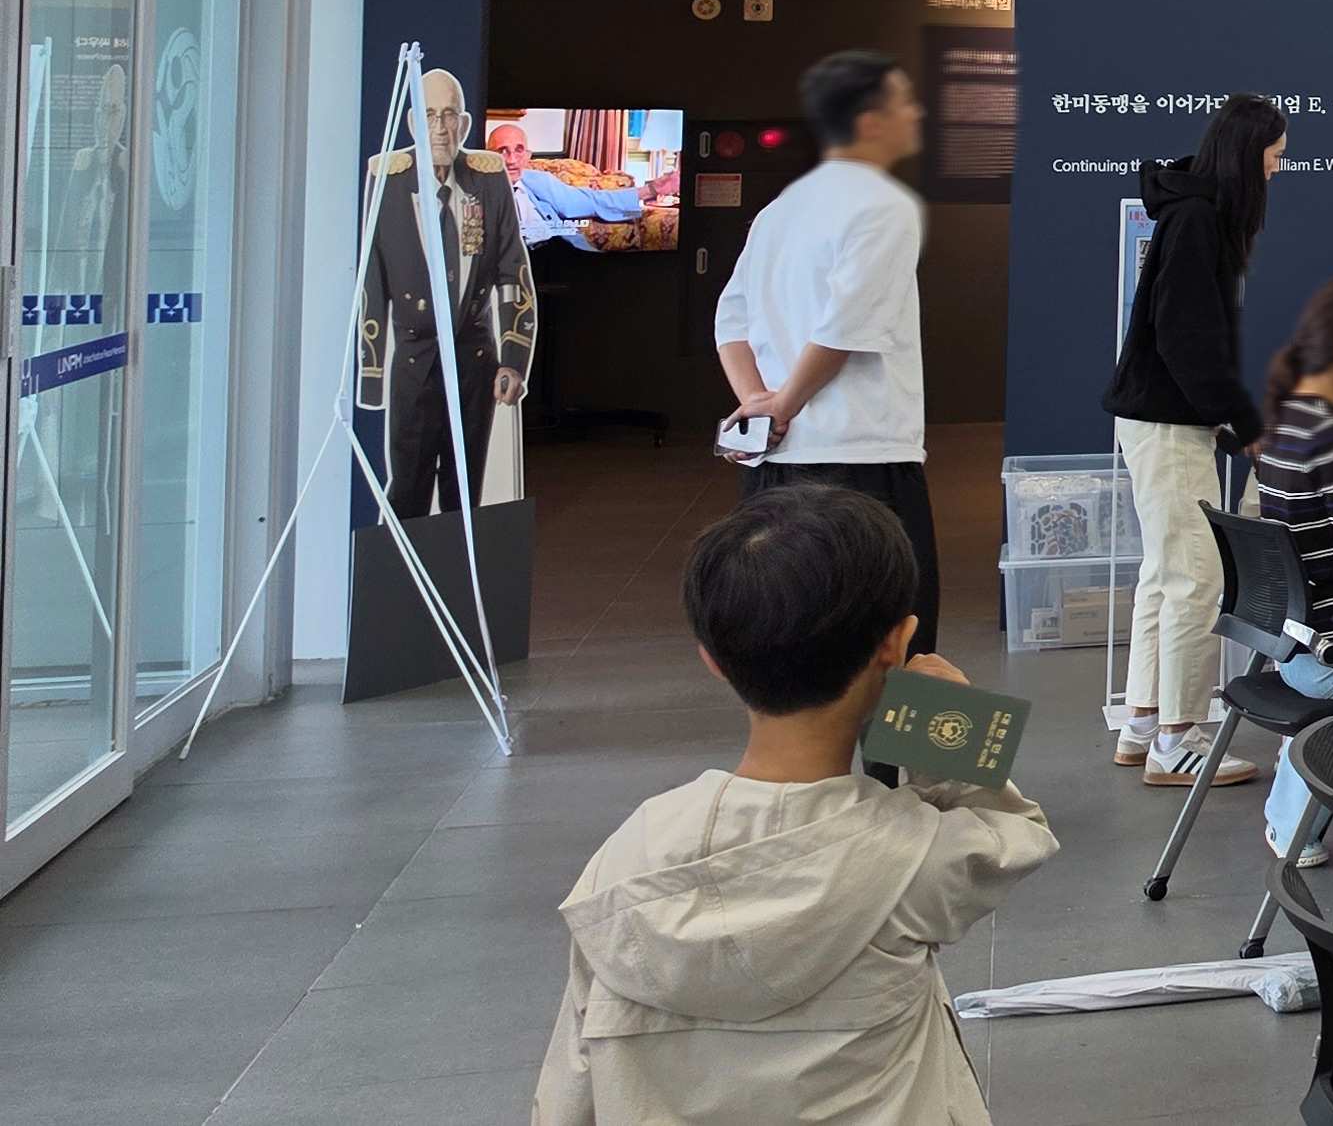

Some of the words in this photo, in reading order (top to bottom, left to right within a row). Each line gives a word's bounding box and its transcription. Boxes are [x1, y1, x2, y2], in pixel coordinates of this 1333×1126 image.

[1052, 94, 1150, 114] 한미동맹을
[1307, 96, 1327, 114] E.
[1052, 158, 1128, 175] Continuing
